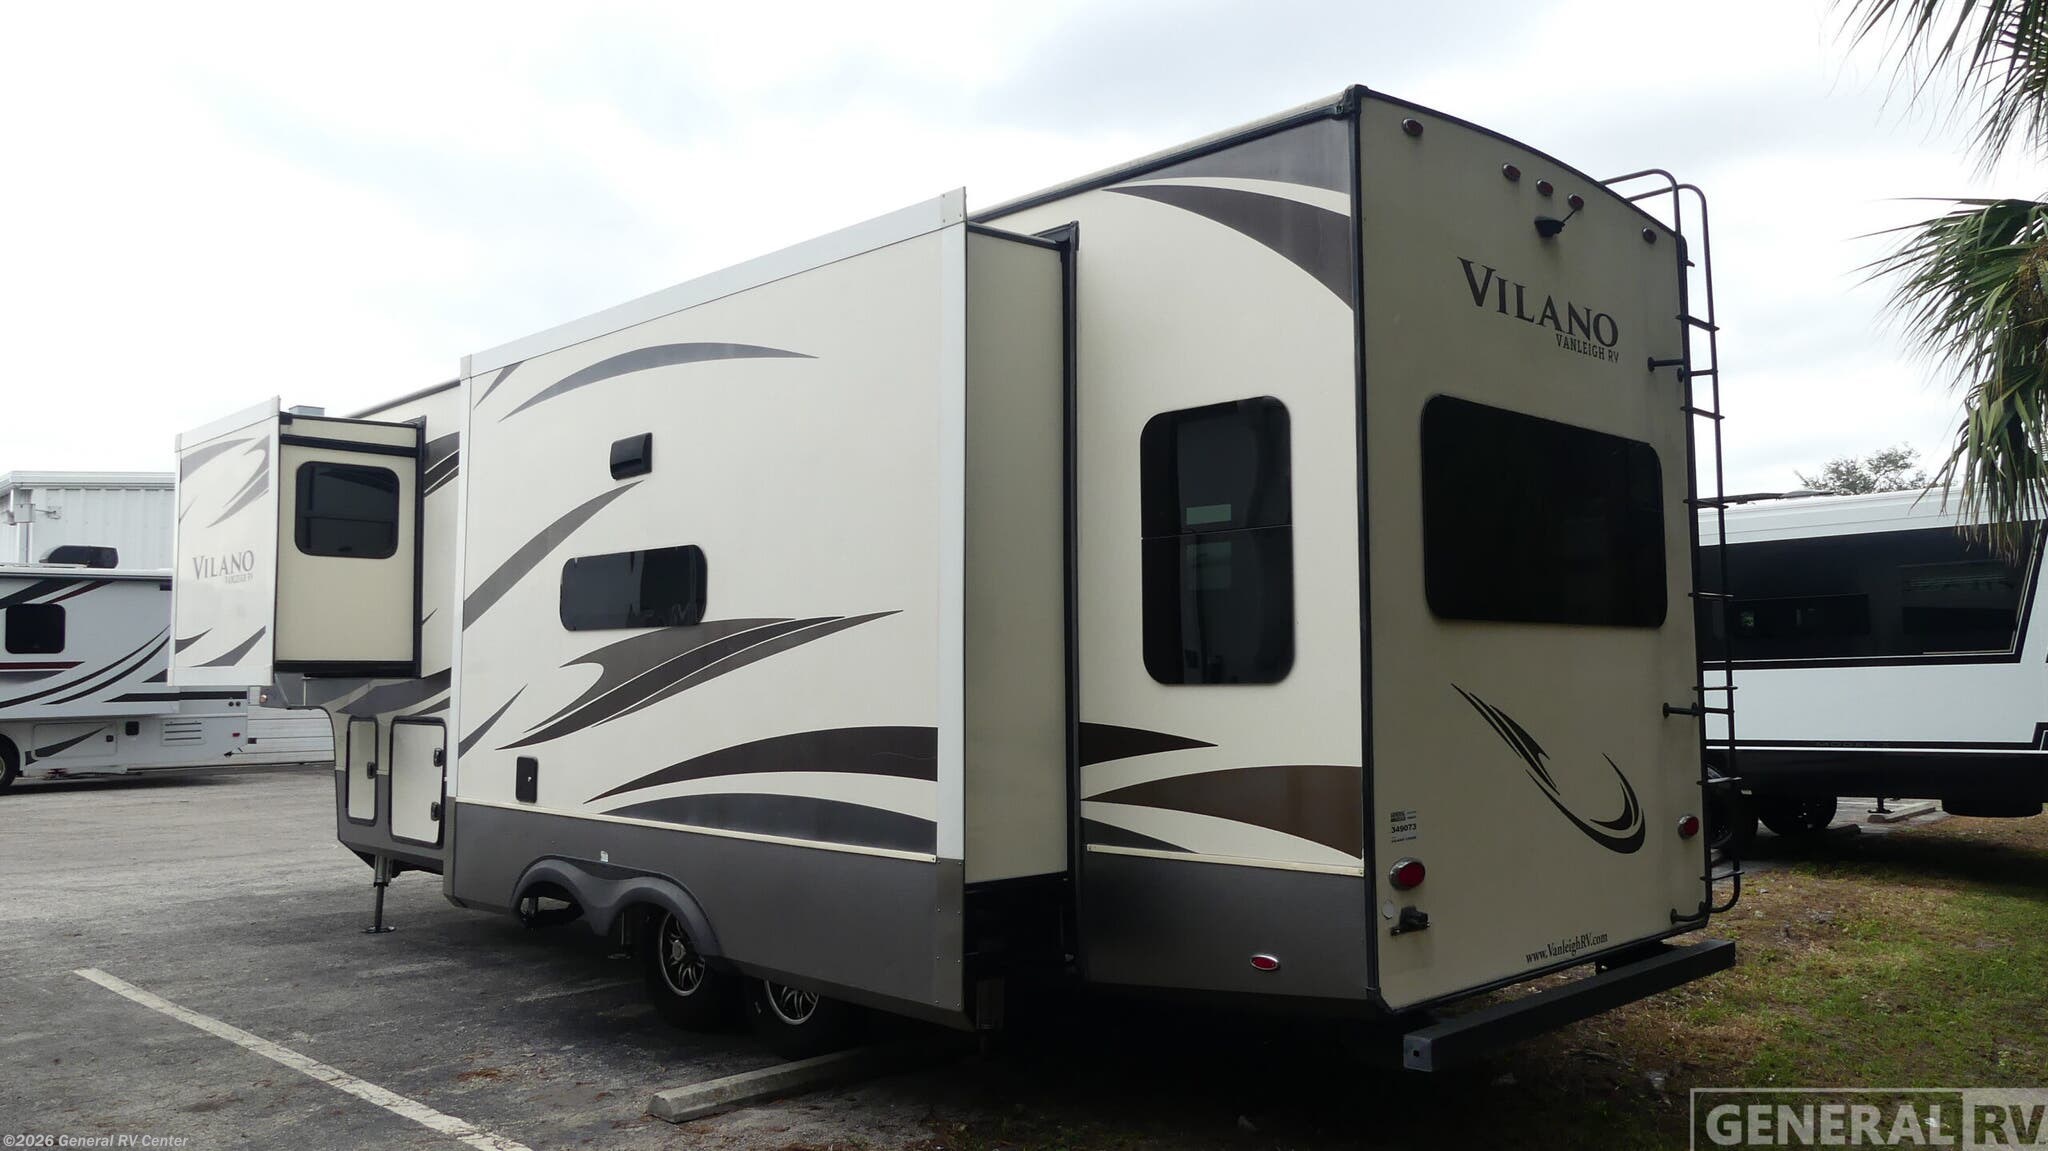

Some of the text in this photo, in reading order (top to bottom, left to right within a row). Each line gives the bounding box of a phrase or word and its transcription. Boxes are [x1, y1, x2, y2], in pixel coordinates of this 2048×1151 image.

[1457, 256, 1619, 348] VILANO
[1555, 333, 1619, 363] VANLEIGH RV
[192, 550, 254, 580] VILANO
[1391, 823, 1417, 833] 349073
[1525, 933, 1608, 963] www.VanleighRV.com
